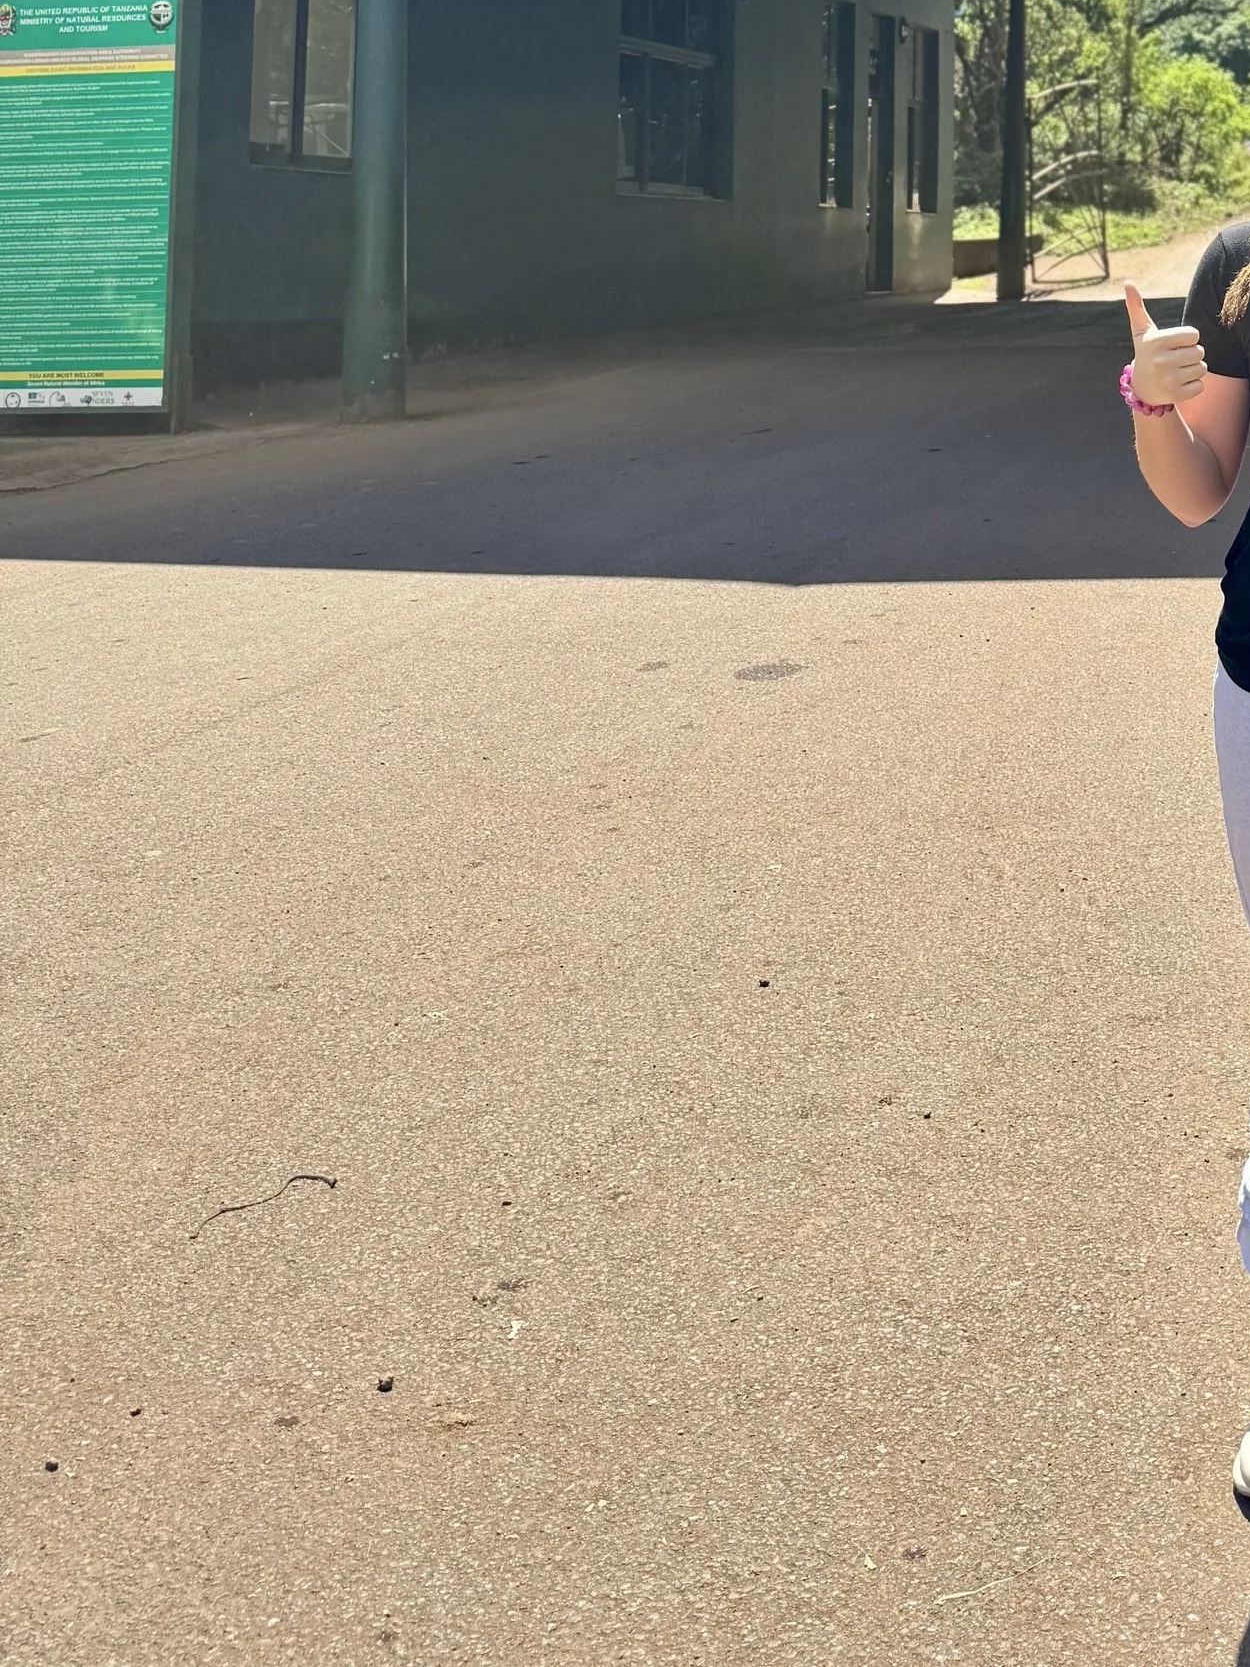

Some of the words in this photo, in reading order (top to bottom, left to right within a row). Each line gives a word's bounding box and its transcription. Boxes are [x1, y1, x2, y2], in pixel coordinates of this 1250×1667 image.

[20, 8, 34, 16] THE
[34, 7, 62, 16] UNITED
[62, 6, 99, 14] REPUBLIC
[111, 4, 149, 13] TANZANIA
[20, 17, 53, 26] MINISTRY
[66, 15, 100, 24] NATURAL
[101, 14, 147, 22] RESOURCES
[58, 25, 75, 34] AND
[75, 24, 109, 33] TOURISM
